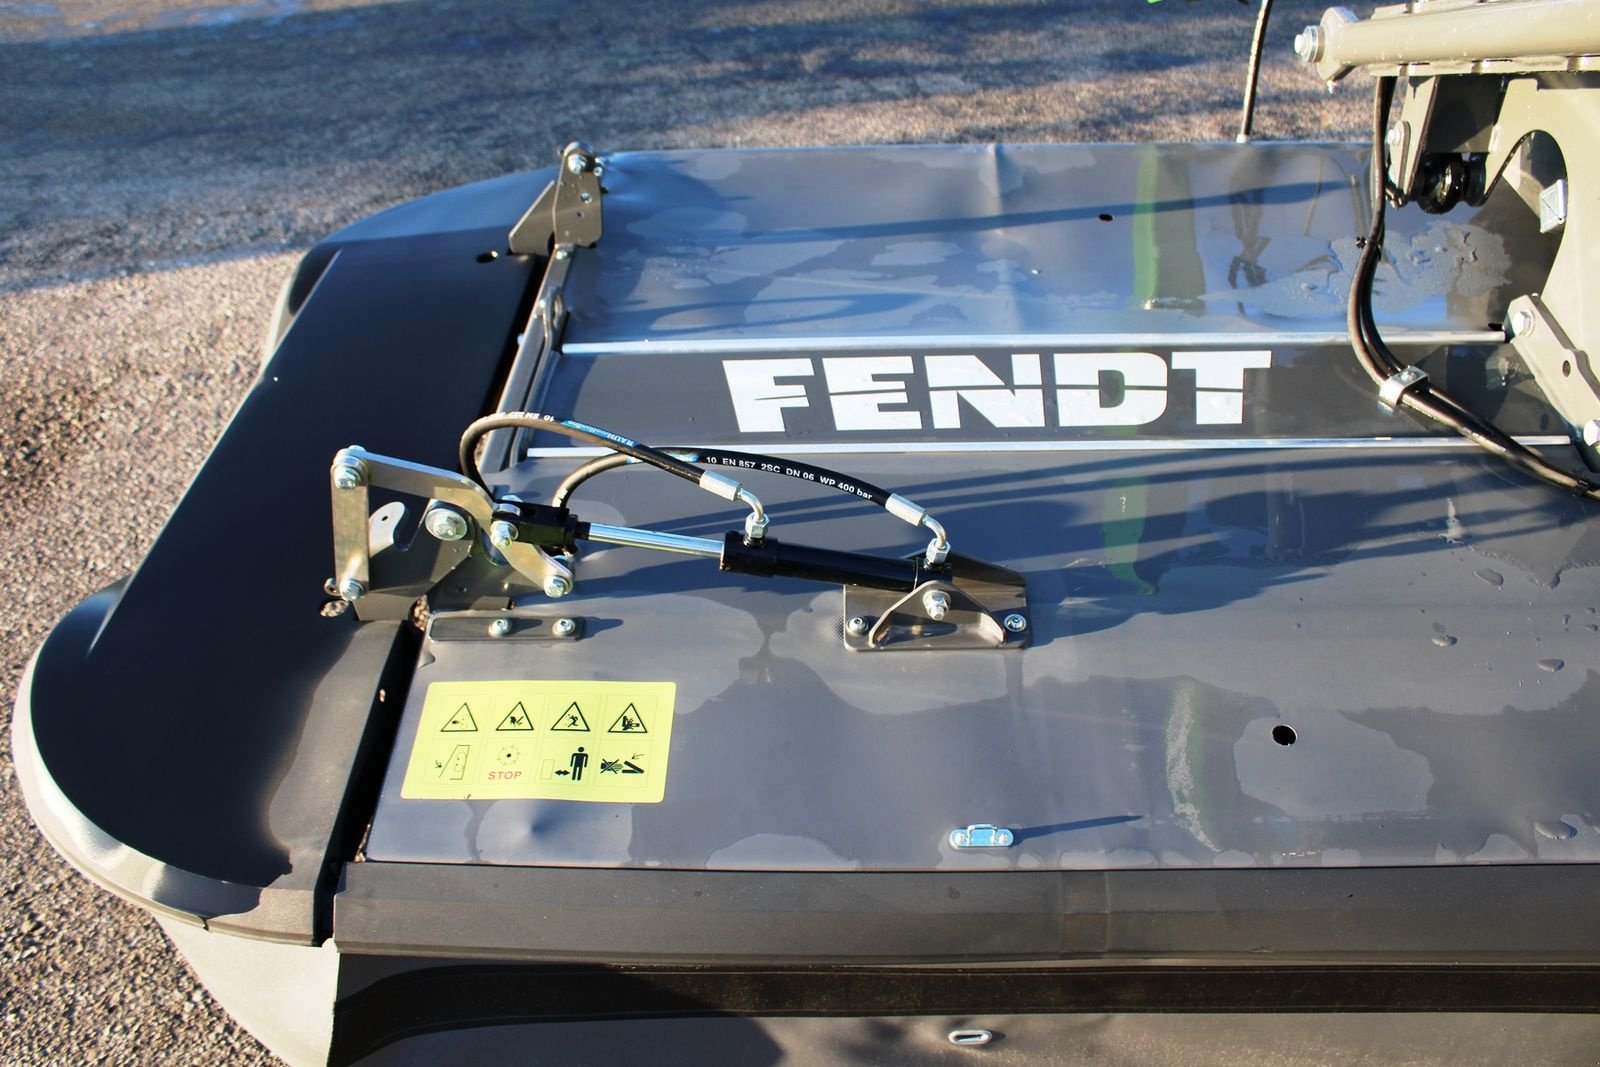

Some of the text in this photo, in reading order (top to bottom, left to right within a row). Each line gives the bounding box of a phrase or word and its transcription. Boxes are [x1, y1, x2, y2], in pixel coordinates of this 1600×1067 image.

[722, 350, 1272, 433] FENDT
[706, 456, 717, 464] 10
[722, 458, 736, 466] EN
[738, 460, 756, 469] 857
[761, 463, 780, 473] 2SC
[785, 468, 800, 477] DN
[802, 472, 815, 481] 06
[820, 476, 836, 486] WP
[837, 482, 855, 493] 400
[856, 488, 873, 500] bar
[488, 771, 522, 780] STOP
